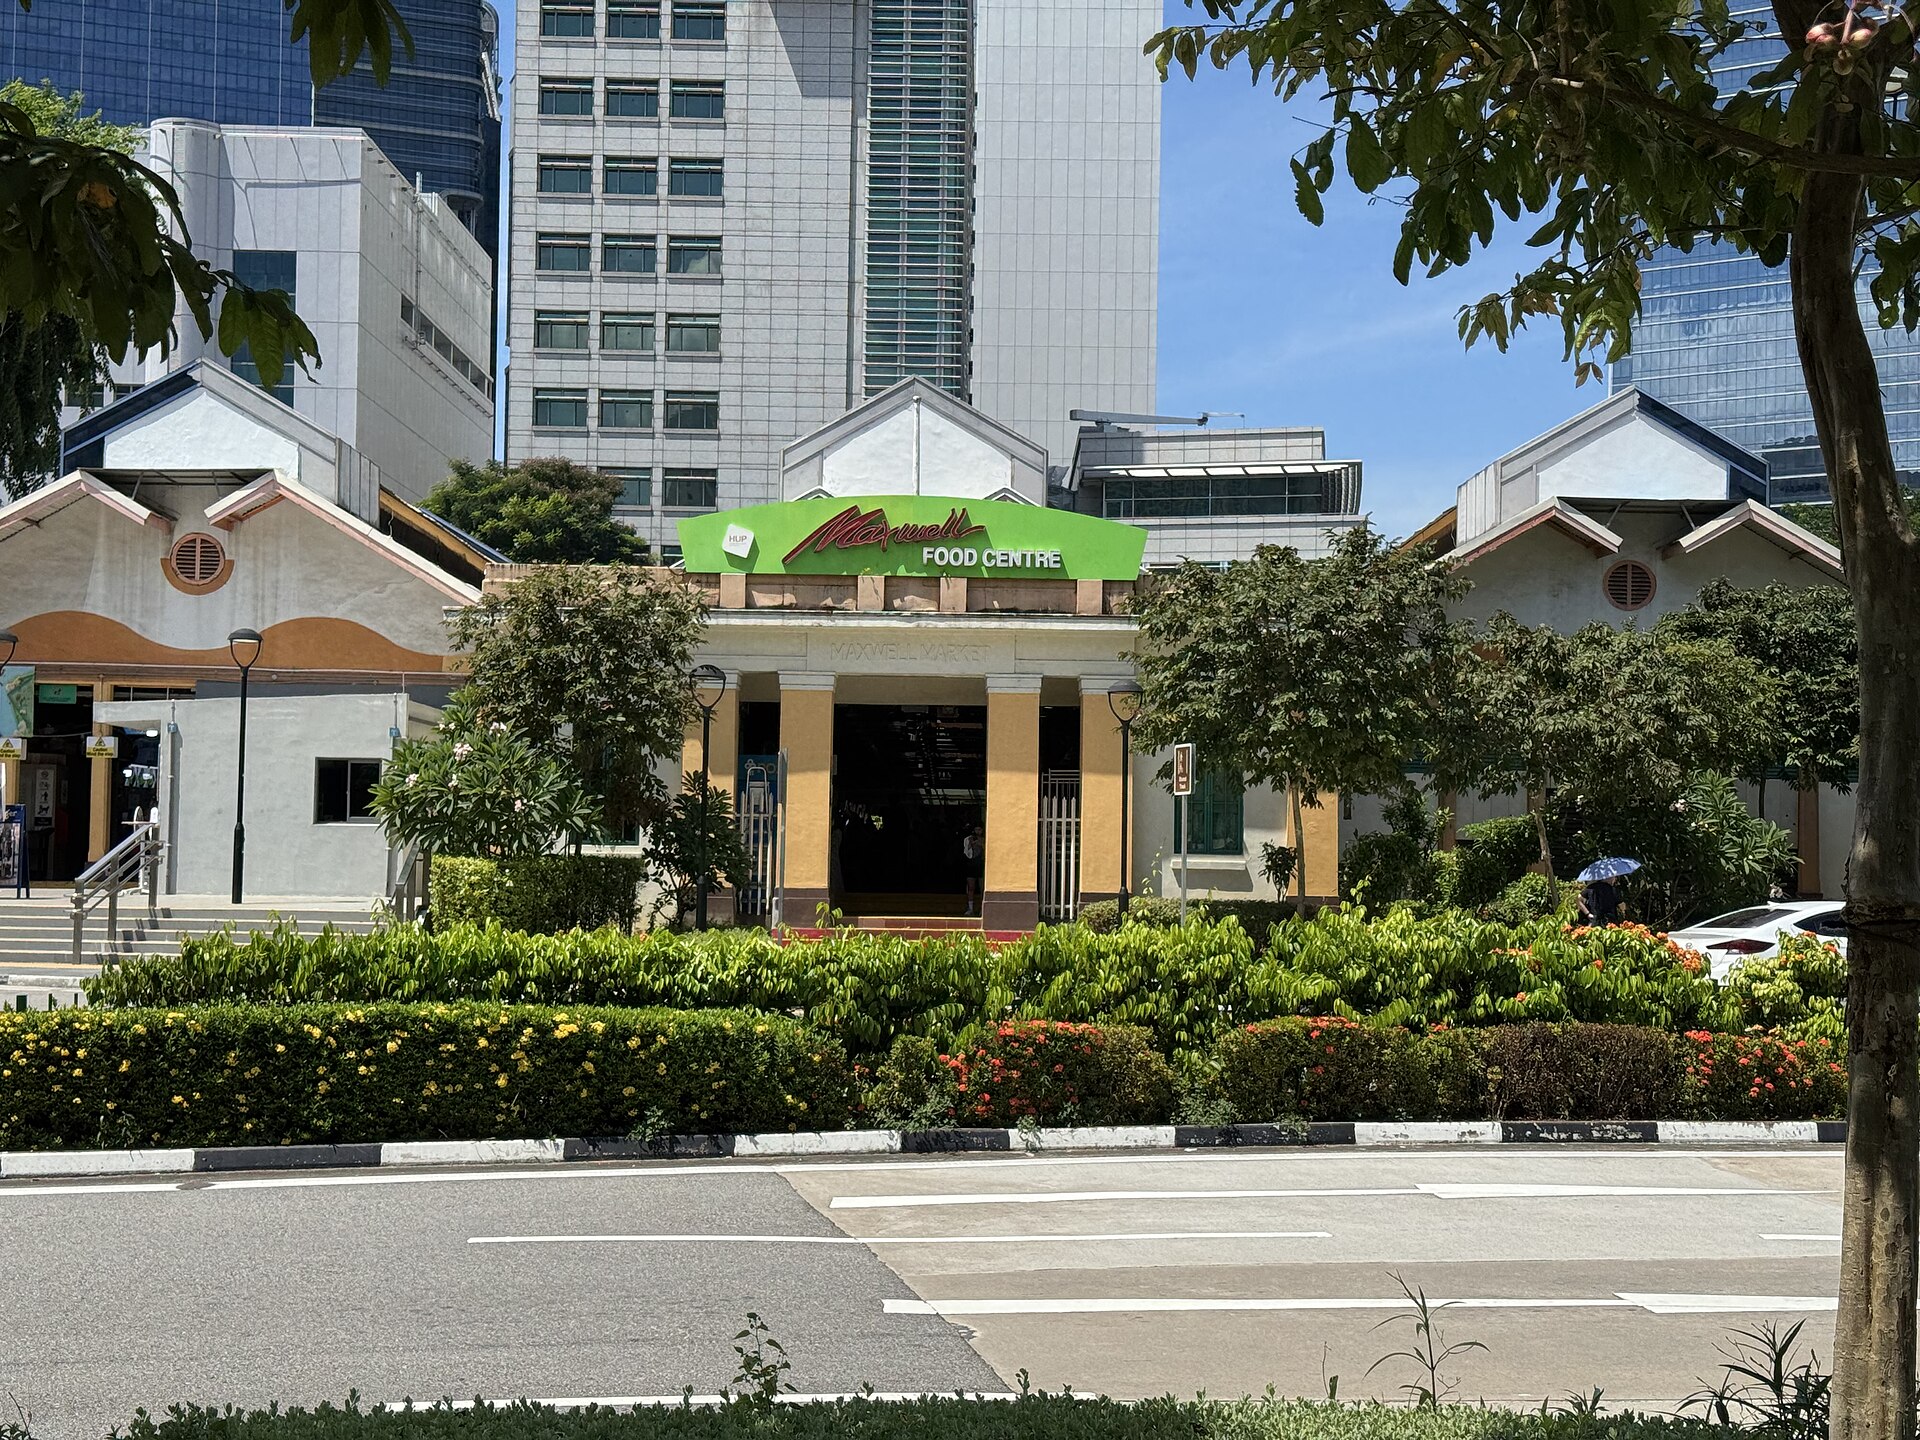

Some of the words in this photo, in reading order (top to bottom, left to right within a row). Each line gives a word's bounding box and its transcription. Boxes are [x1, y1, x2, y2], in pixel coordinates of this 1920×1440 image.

[781, 505, 985, 564] Maxwell
[922, 547, 977, 567] FOOD
[982, 548, 1061, 569] CENTRE
[830, 642, 917, 661] MAXWELL
[920, 644, 991, 662] MARKET
